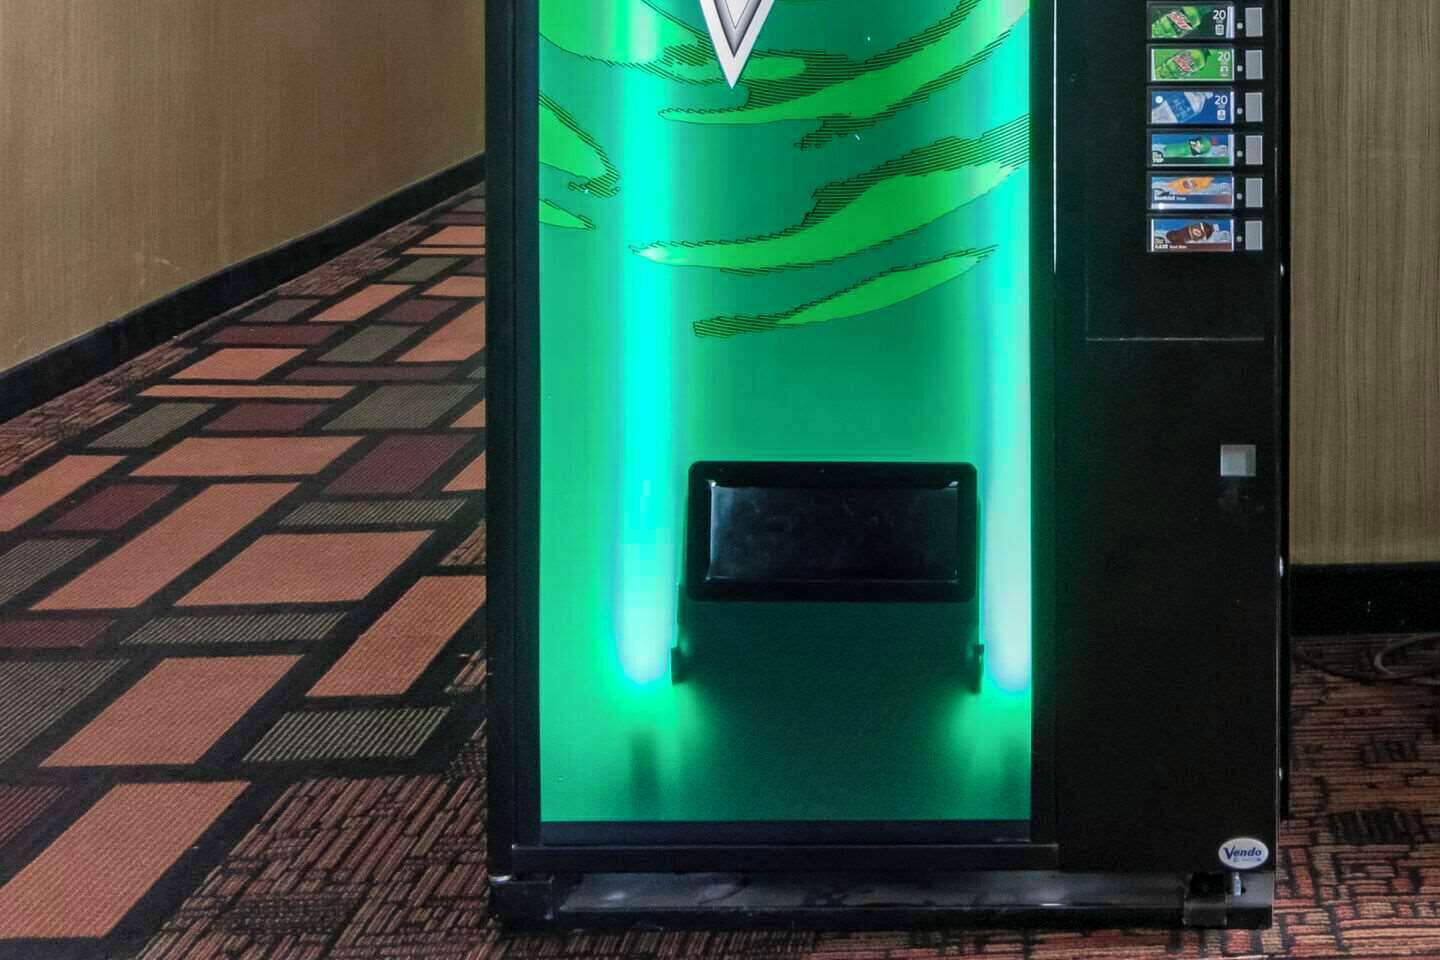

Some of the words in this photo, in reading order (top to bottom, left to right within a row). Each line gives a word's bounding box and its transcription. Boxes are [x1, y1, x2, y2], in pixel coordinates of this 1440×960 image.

[1213, 10, 1226, 20] 20
[1217, 51, 1231, 62] 20
[1214, 95, 1228, 105] 20
[1223, 846, 1262, 859] Vendo
